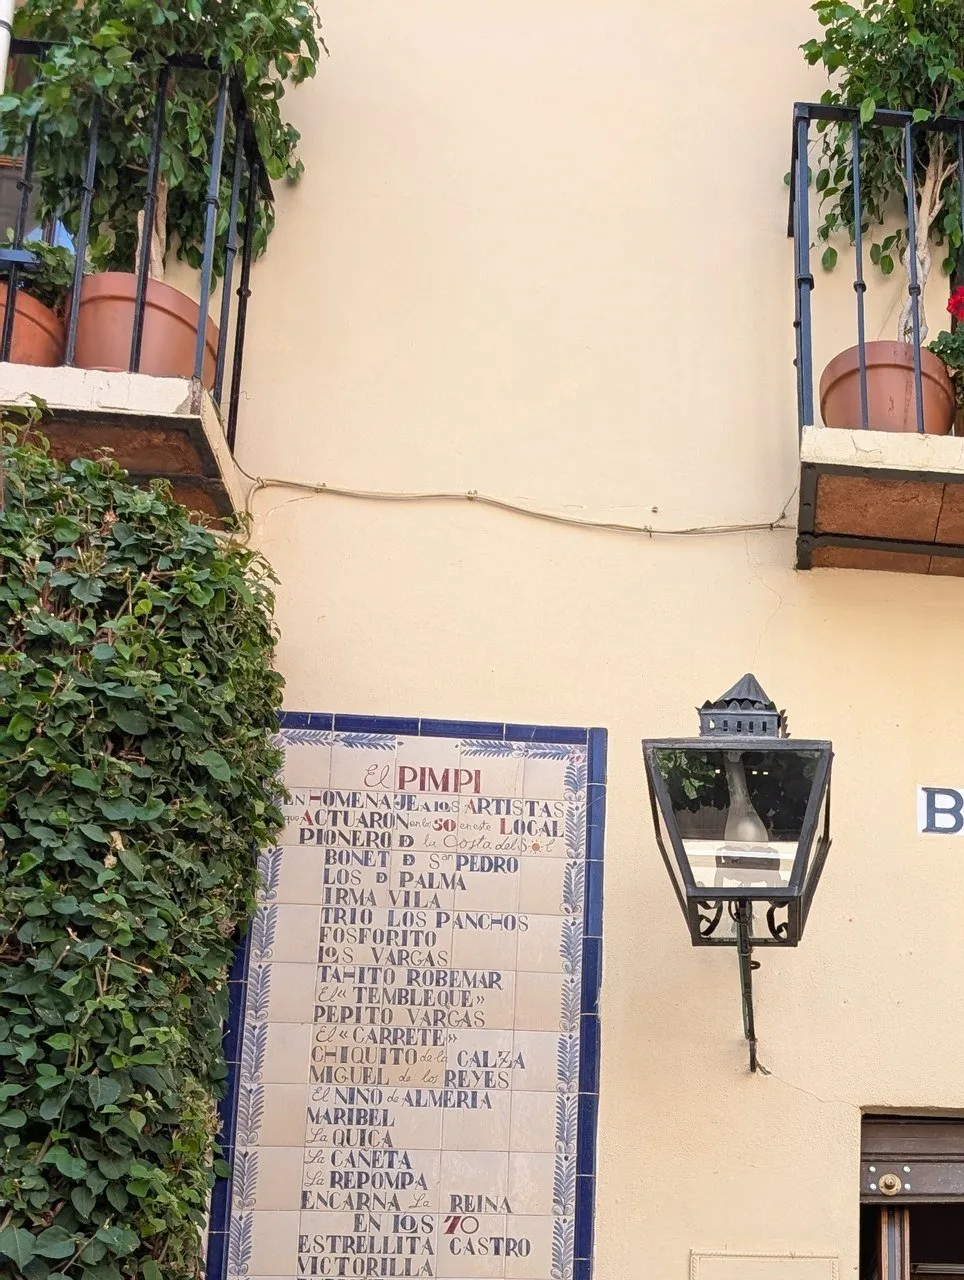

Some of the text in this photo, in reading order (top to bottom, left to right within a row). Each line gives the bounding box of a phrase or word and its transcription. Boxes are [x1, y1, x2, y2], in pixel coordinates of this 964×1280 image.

[364, 764, 481, 794] El PIMPI
[308, 789, 419, 812] HOMENAJE
[465, 798, 564, 818] ARTISTAS
[300, 809, 410, 830] ACTUARON
[432, 818, 457, 832] 50
[500, 817, 565, 838] LOCAL
[299, 828, 392, 848] PIONERO
[443, 834, 491, 851] Costa
[324, 848, 390, 867] BONET
[456, 854, 519, 873] PEDRO
[323, 868, 361, 886] LOS
[399, 871, 467, 890] PALMA
[324, 887, 441, 908] IRMA VILA
[321, 907, 529, 932] TRIO LOS PANCHOS
[319, 926, 437, 948] FOSFORITO
[371, 947, 448, 967] VARGAS
[406, 968, 504, 991] ROBEMAR
[318, 986, 338, 1003] El
[312, 1005, 485, 1028] PEPITO VARGAS
[315, 1026, 338, 1043] El
[311, 1046, 418, 1066] CHIQUITO
[457, 1050, 526, 1069] CALZA
[309, 1065, 510, 1089] MIGUEL de los REYES
[312, 1086, 331, 1103] El
[387, 1088, 400, 1103] de
[401, 1089, 493, 1110] ALMERIA
[306, 1106, 395, 1127] MARIBEL
[305, 1128, 394, 1148] La QUICA
[304, 1147, 413, 1170] La CAÑETA
[304, 1170, 429, 1191] La REPOMPA
[301, 1190, 514, 1214] ENCARNA La REINA
[353, 1213, 381, 1233] EN
[443, 1215, 480, 1235] 70
[298, 1235, 531, 1258] ESTRELLITA CASTRO
[297, 1256, 434, 1277] VICTORILLA
